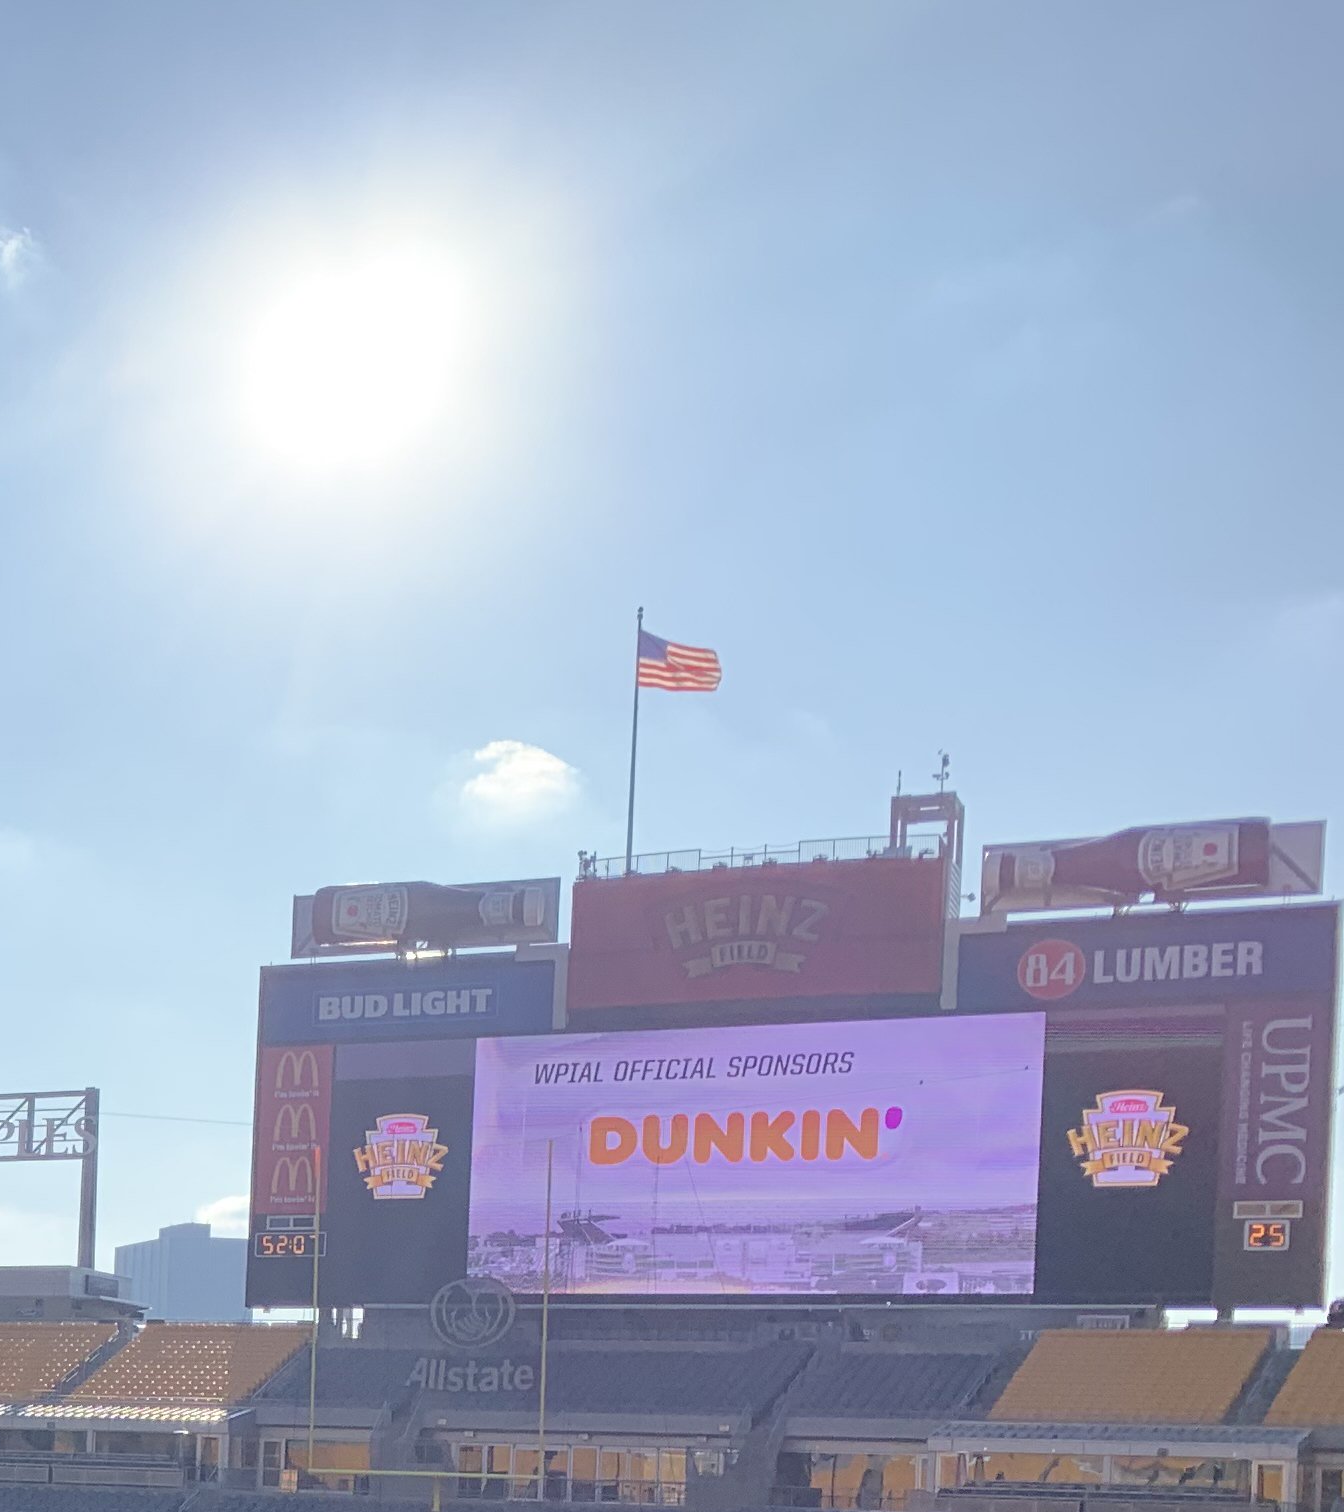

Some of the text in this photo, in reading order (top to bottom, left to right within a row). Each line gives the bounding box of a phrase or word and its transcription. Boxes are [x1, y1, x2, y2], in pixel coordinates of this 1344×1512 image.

[665, 895, 830, 949] HEINZ
[718, 943, 770, 962] FIELD
[1025, 941, 1264, 987] 84 LUMBER
[319, 988, 493, 1021] BUD LIGHT
[534, 1051, 855, 1085] WPIAL OFFICIAL SPONSORS
[1255, 1015, 1313, 1186] UPMC
[588, 1106, 903, 1166] DUNKIN'
[1066, 1119, 1190, 1157] HEINZ
[353, 1139, 449, 1174] HEINZ
[1109, 1152, 1145, 1165] FIELD
[1249, 1223, 1285, 1247] 25
[406, 1357, 534, 1392] Allstate
